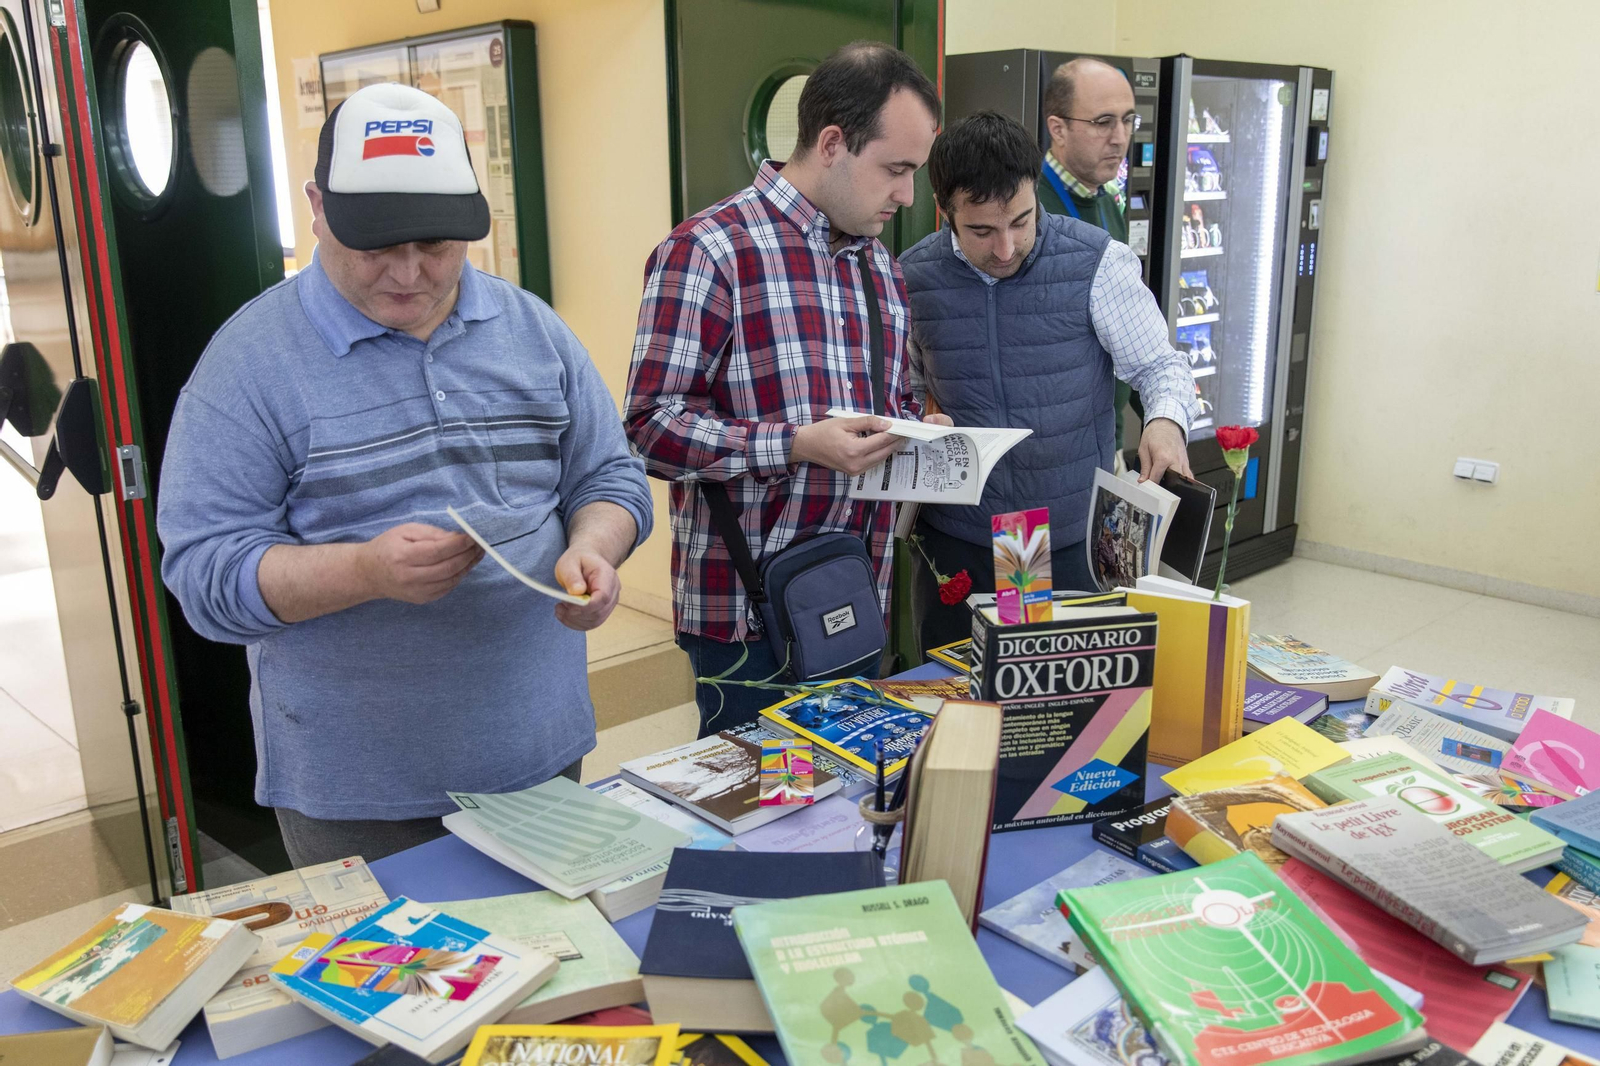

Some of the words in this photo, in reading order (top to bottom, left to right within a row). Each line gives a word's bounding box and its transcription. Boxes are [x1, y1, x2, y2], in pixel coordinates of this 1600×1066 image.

[364, 119, 434, 138] PEPSI
[827, 611, 850, 623] Reebok
[997, 628, 1142, 657] DICCIONARIO
[994, 652, 1140, 699] OXFORD
[1003, 714, 1036, 722] ratamiento
[1053, 711, 1074, 719] lengua
[1003, 720, 1047, 728] ontemporánea
[1075, 769, 1116, 783] Nueva
[1352, 770, 1386, 784] Prospects
[1387, 768, 1400, 776] for
[1400, 765, 1412, 773] the
[1069, 780, 1121, 793] Edición
[992, 823, 1003, 831] La
[1004, 819, 1035, 830] máxima
[1036, 814, 1074, 826] autoridad
[1310, 821, 1334, 831] Le
[1333, 816, 1367, 832] petit
[1361, 808, 1401, 823] Livre
[1452, 827, 1473, 836] OD
[1471, 814, 1516, 831] SYSTEM
[1349, 830, 1371, 840] de
[1150, 839, 1170, 849] Libro
[1275, 823, 1307, 848] Raymond
[1308, 843, 1330, 863] Seroul
[1341, 863, 1353, 878] Le
[1354, 876, 1376, 895] petit
[636, 864, 663, 876] libro
[621, 875, 634, 883] de
[295, 904, 328, 920] en
[861, 902, 892, 913] RUSSELL
[904, 897, 930, 908] DRAGO
[298, 901, 379, 928] perspectiva
[509, 1042, 628, 1064] NATIONAL
